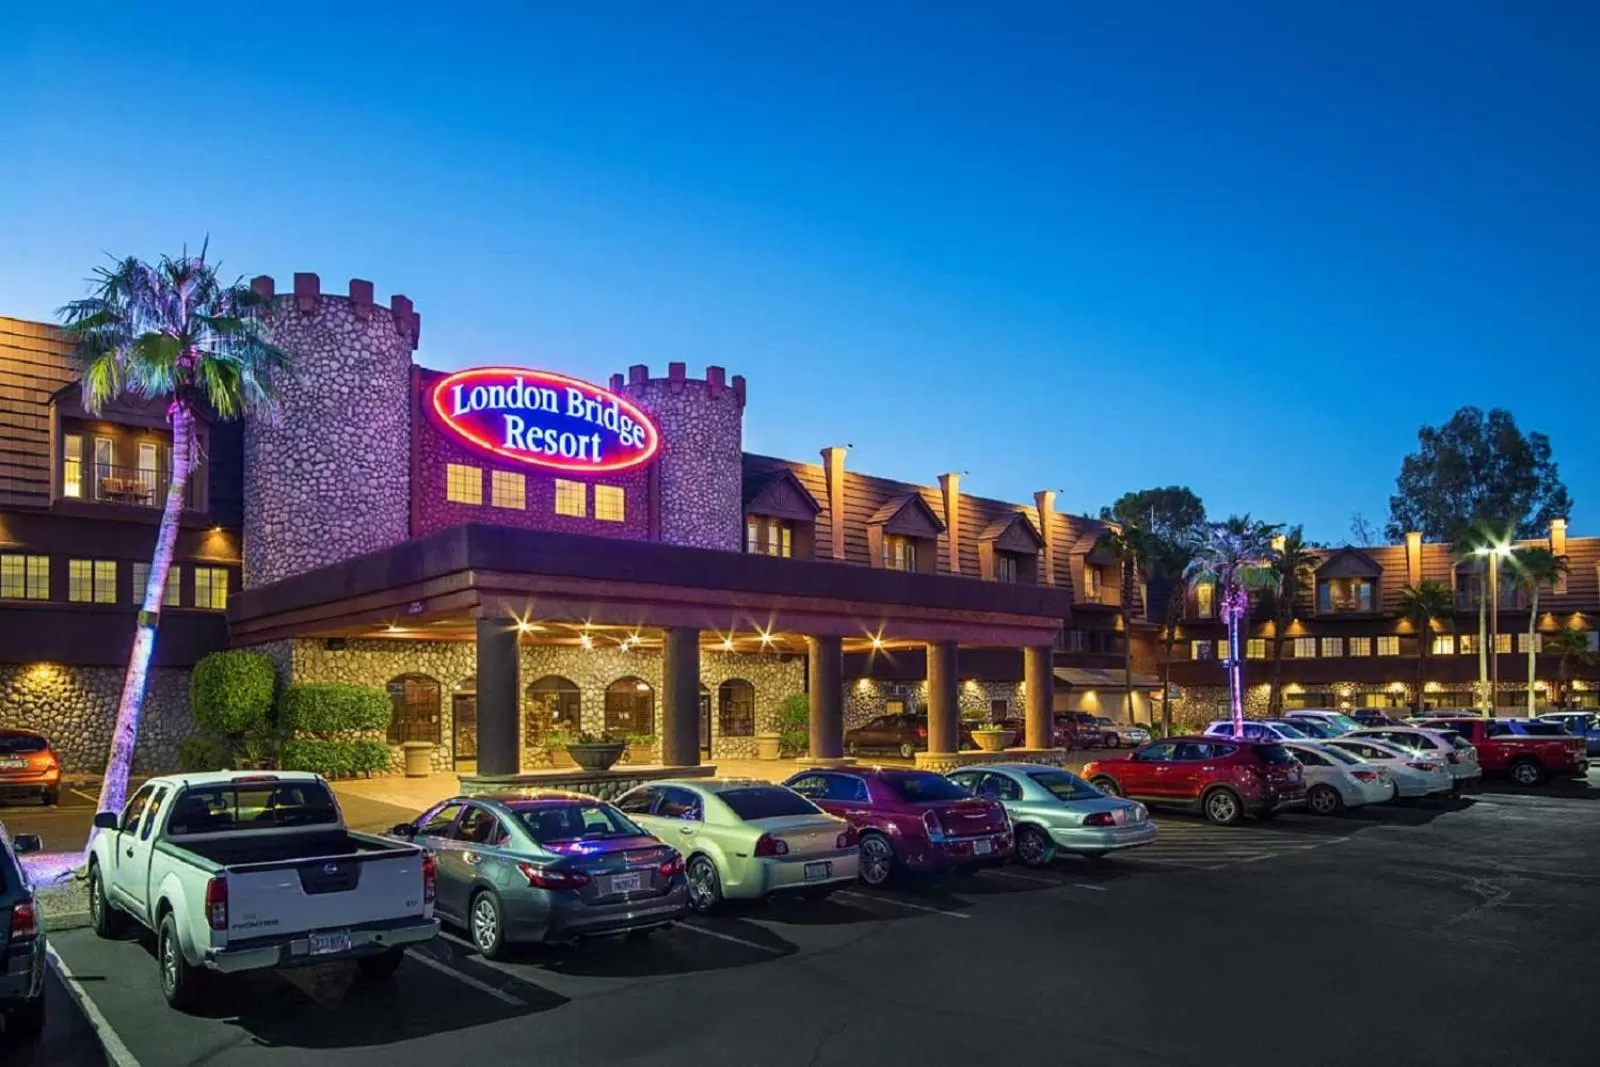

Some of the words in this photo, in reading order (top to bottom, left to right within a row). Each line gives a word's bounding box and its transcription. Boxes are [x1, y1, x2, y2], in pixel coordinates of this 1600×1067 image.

[452, 377, 560, 417] London
[565, 387, 645, 448] Bridge
[503, 414, 602, 463] Resort
